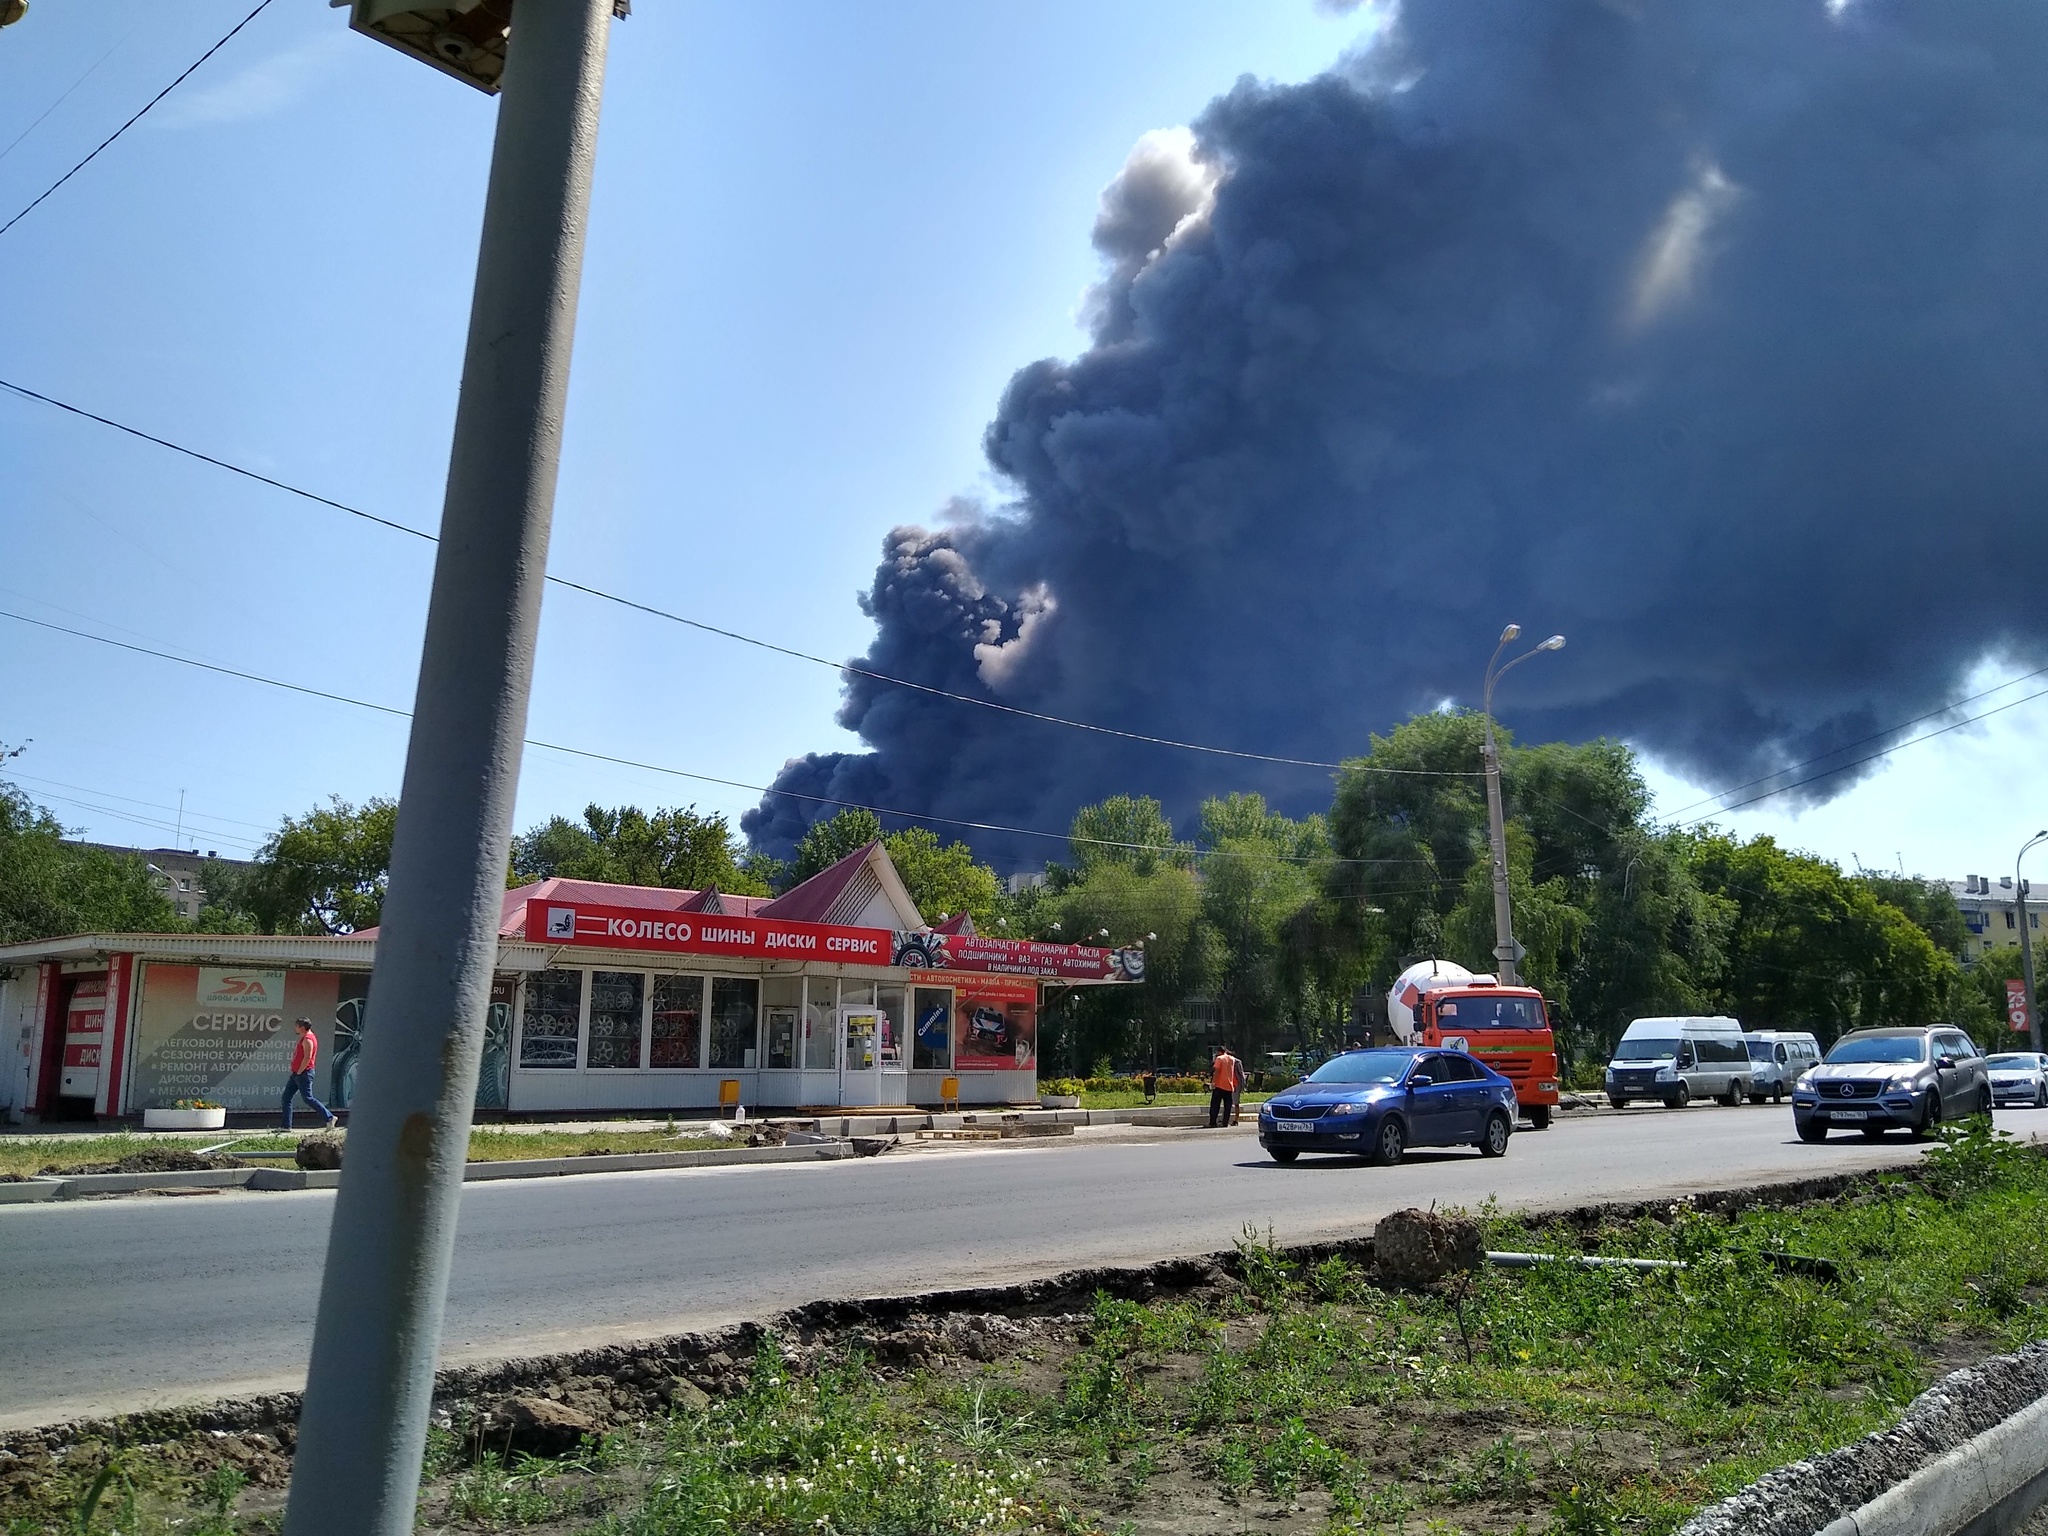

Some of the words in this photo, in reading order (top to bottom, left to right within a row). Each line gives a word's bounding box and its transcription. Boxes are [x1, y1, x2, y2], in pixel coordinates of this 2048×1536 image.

[607, 918, 692, 941] КОЛЕСО
[701, 927, 756, 945] ШИНЫ
[765, 932, 817, 949] ДИСКИ
[826, 936, 878, 954] СЕРВИС
[965, 937, 1020, 951] АВТОЗАПЧАСТИ
[1030, 943, 1068, 956] ИНОМАРКИ
[1077, 947, 1100, 958] МАСЛА
[958, 949, 1007, 962] ПОДШИПНИКИ
[1018, 954, 1031, 964] ВАЗ
[1041, 956, 1053, 966] ГАЗ
[1062, 958, 1100, 969] АВТОХИМИЯ
[987, 963, 992, 971] В
[992, 963, 1022, 974] НАЛИЧИИ
[1022, 965, 1027, 973] И
[1027, 966, 1040, 977] ПОД
[1040, 967, 1058, 976] ЗАКАЗ
[926, 974, 977, 985] АВТОКОСМЕТИКА
[206, 994, 233, 1002] ШИНЫ
[84, 1014, 105, 1029] ШИН
[192, 1013, 283, 1032] СЕРВИС
[917, 1003, 944, 1037] Cummins
[2011, 1010, 2026, 1030] 9
[162, 1037, 224, 1049] ЛЕГКОВОЙ
[160, 1050, 225, 1060] СЕЗОННОЕ
[228, 1051, 283, 1061] ХРАНЕНИЕ
[160, 1062, 208, 1072] РЕМОНТ
[159, 1074, 208, 1085] ДИСКОВ
[158, 1085, 259, 1096] МЕЛКОСРОЧНЫЙ
